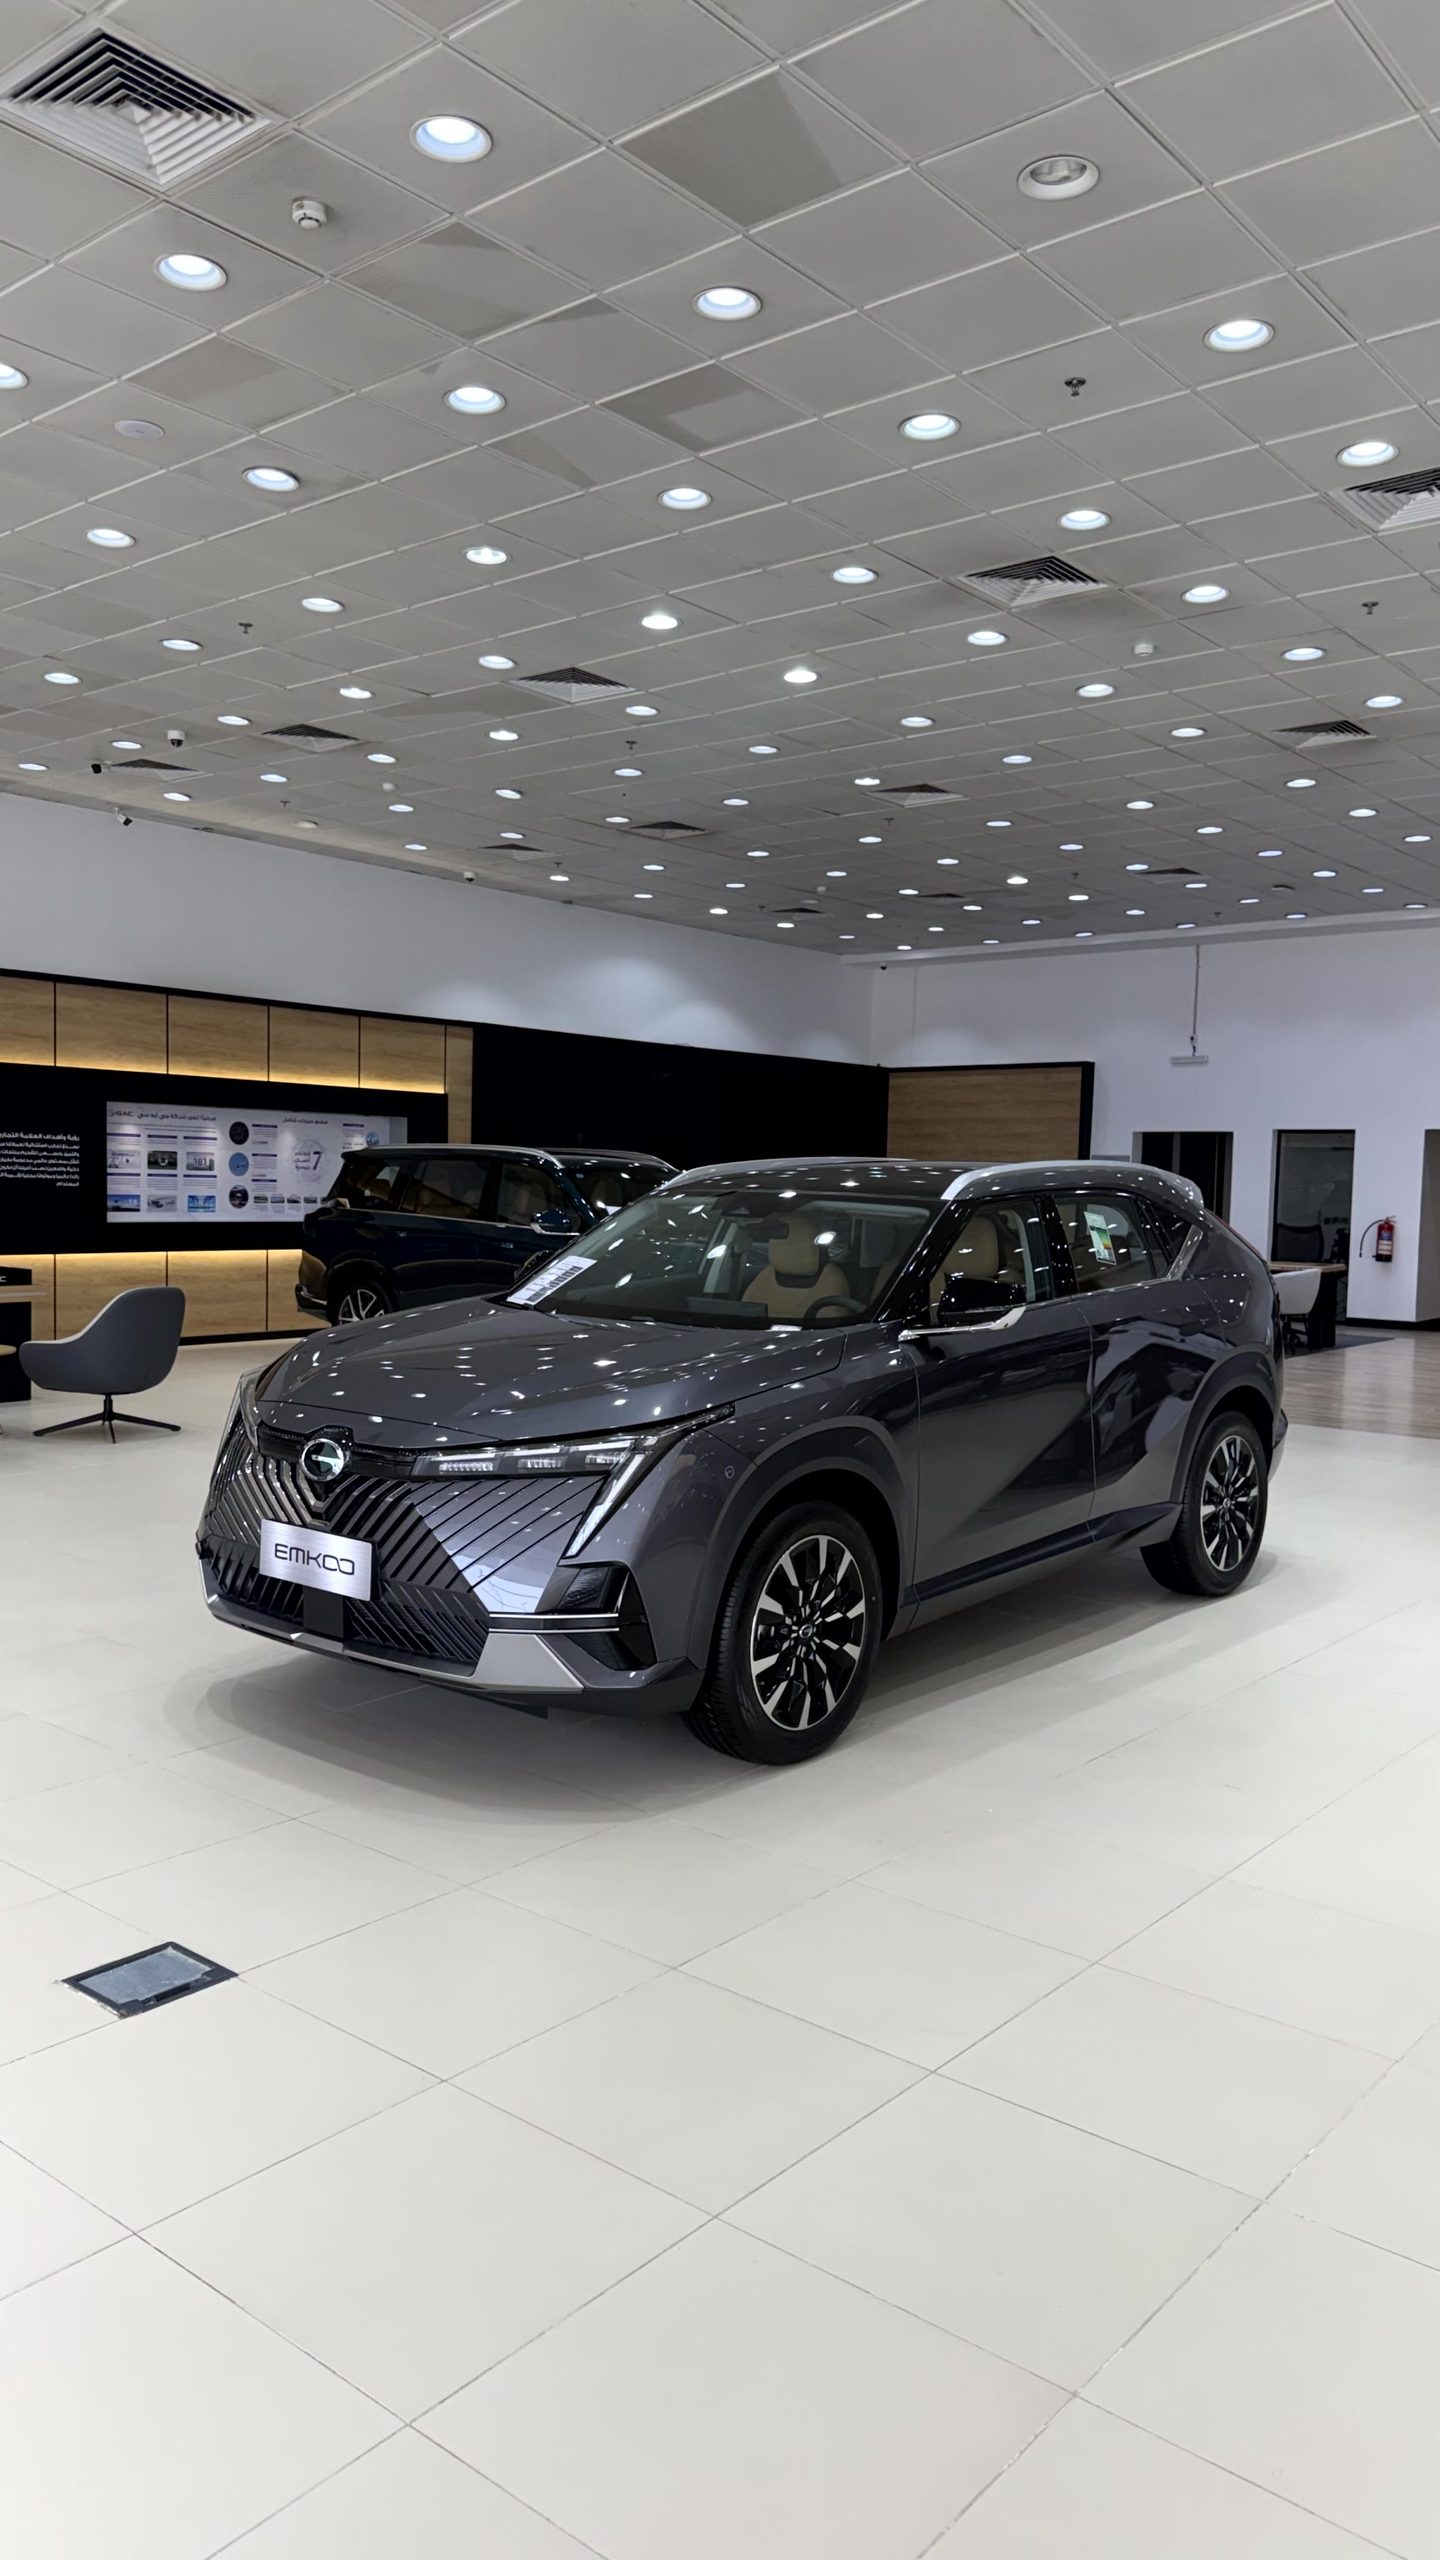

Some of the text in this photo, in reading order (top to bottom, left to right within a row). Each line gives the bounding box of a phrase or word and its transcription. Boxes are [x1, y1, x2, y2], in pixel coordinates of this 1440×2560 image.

[193, 1157, 207, 1168] 181
[313, 1150, 322, 1170] 7
[274, 1542, 356, 1576] EMKOO
